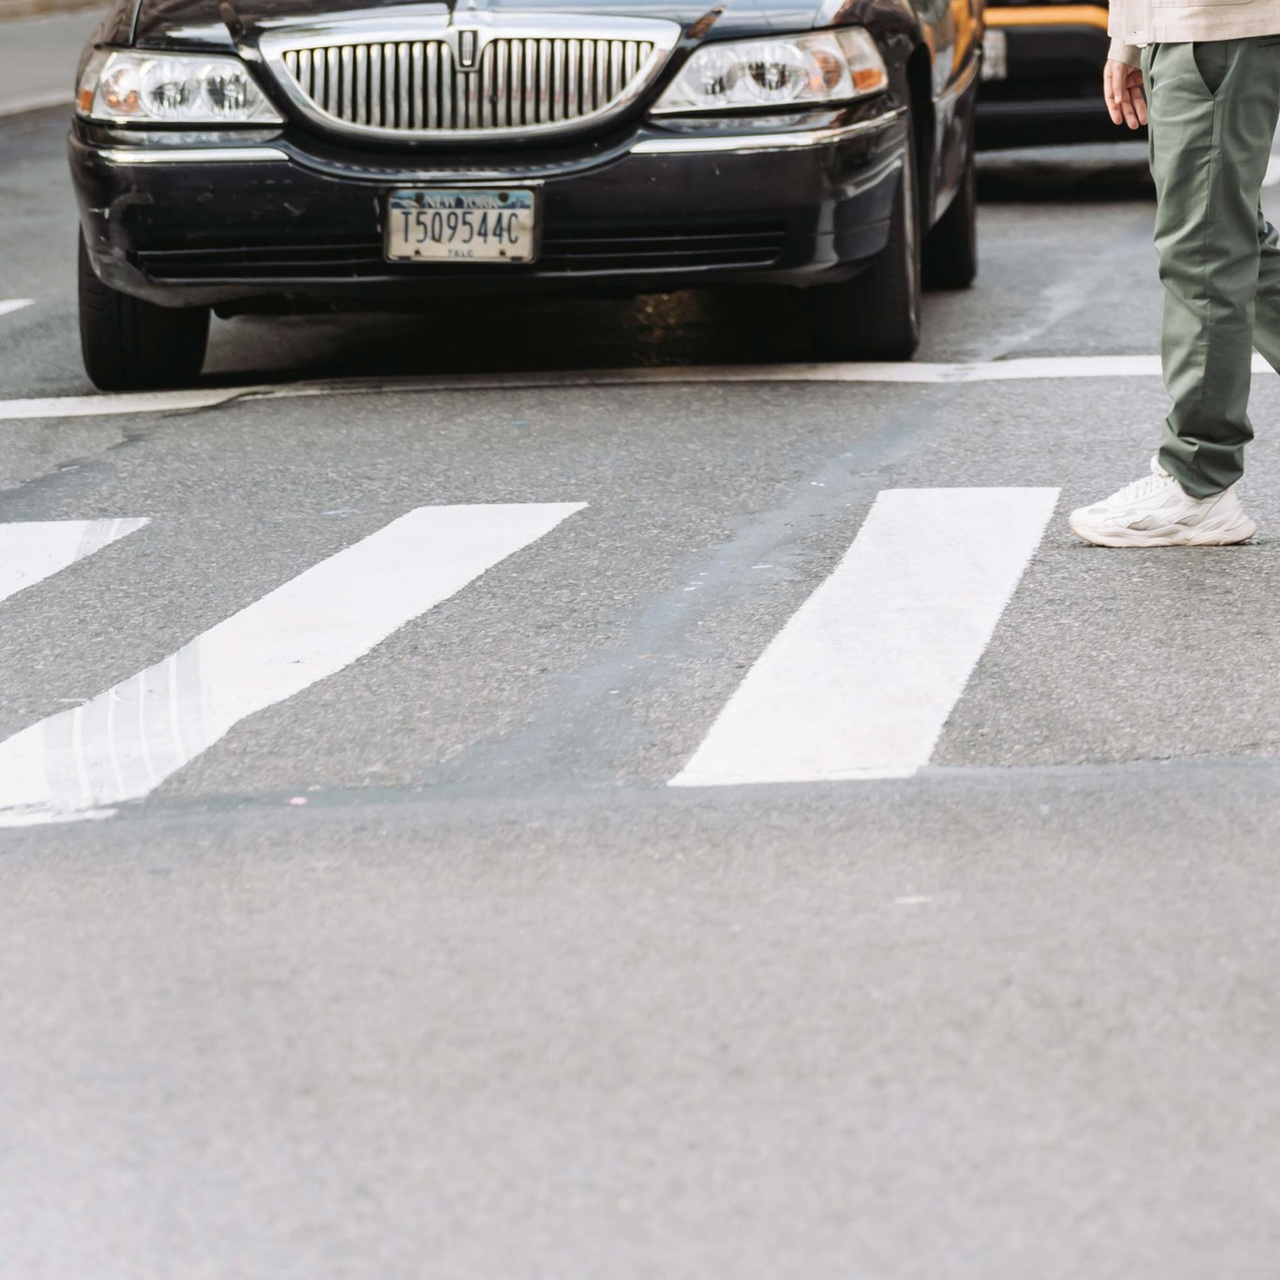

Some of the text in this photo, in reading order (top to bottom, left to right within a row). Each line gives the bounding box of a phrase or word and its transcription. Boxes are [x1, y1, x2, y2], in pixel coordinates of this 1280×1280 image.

[424, 196, 498, 209] NEW YORK
[401, 211, 519, 244] T509544C
